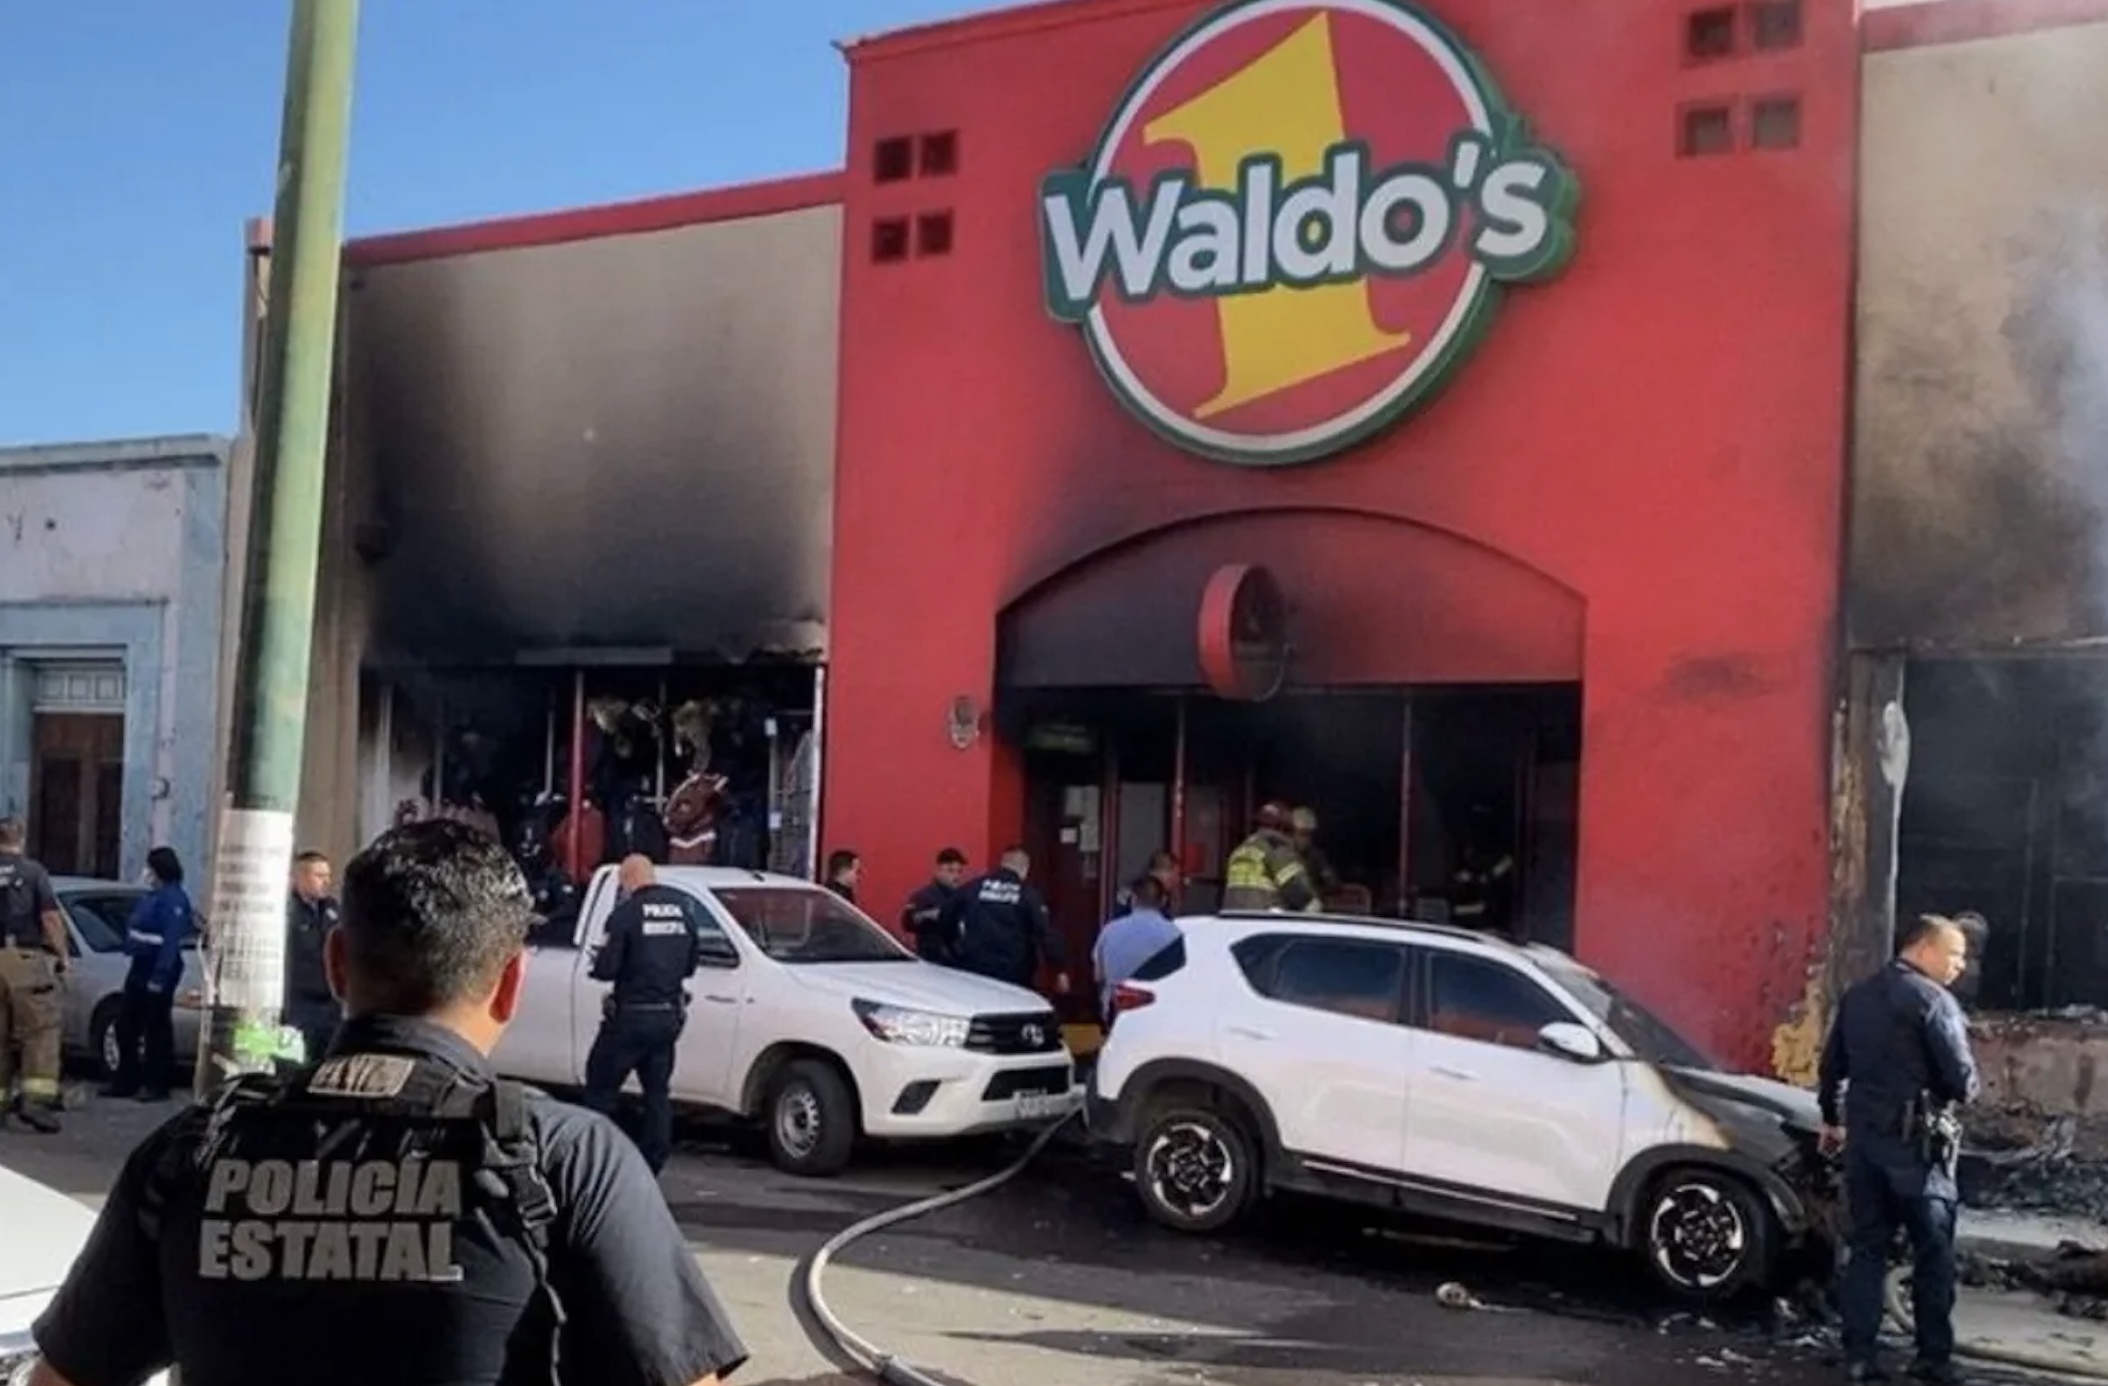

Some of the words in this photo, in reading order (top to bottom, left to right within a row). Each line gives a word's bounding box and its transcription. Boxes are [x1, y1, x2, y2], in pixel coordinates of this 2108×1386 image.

[1044, 142, 1547, 301] Waldo's
[1143, 10, 1411, 418] 1
[199, 1219, 464, 1281] ESTATAL
